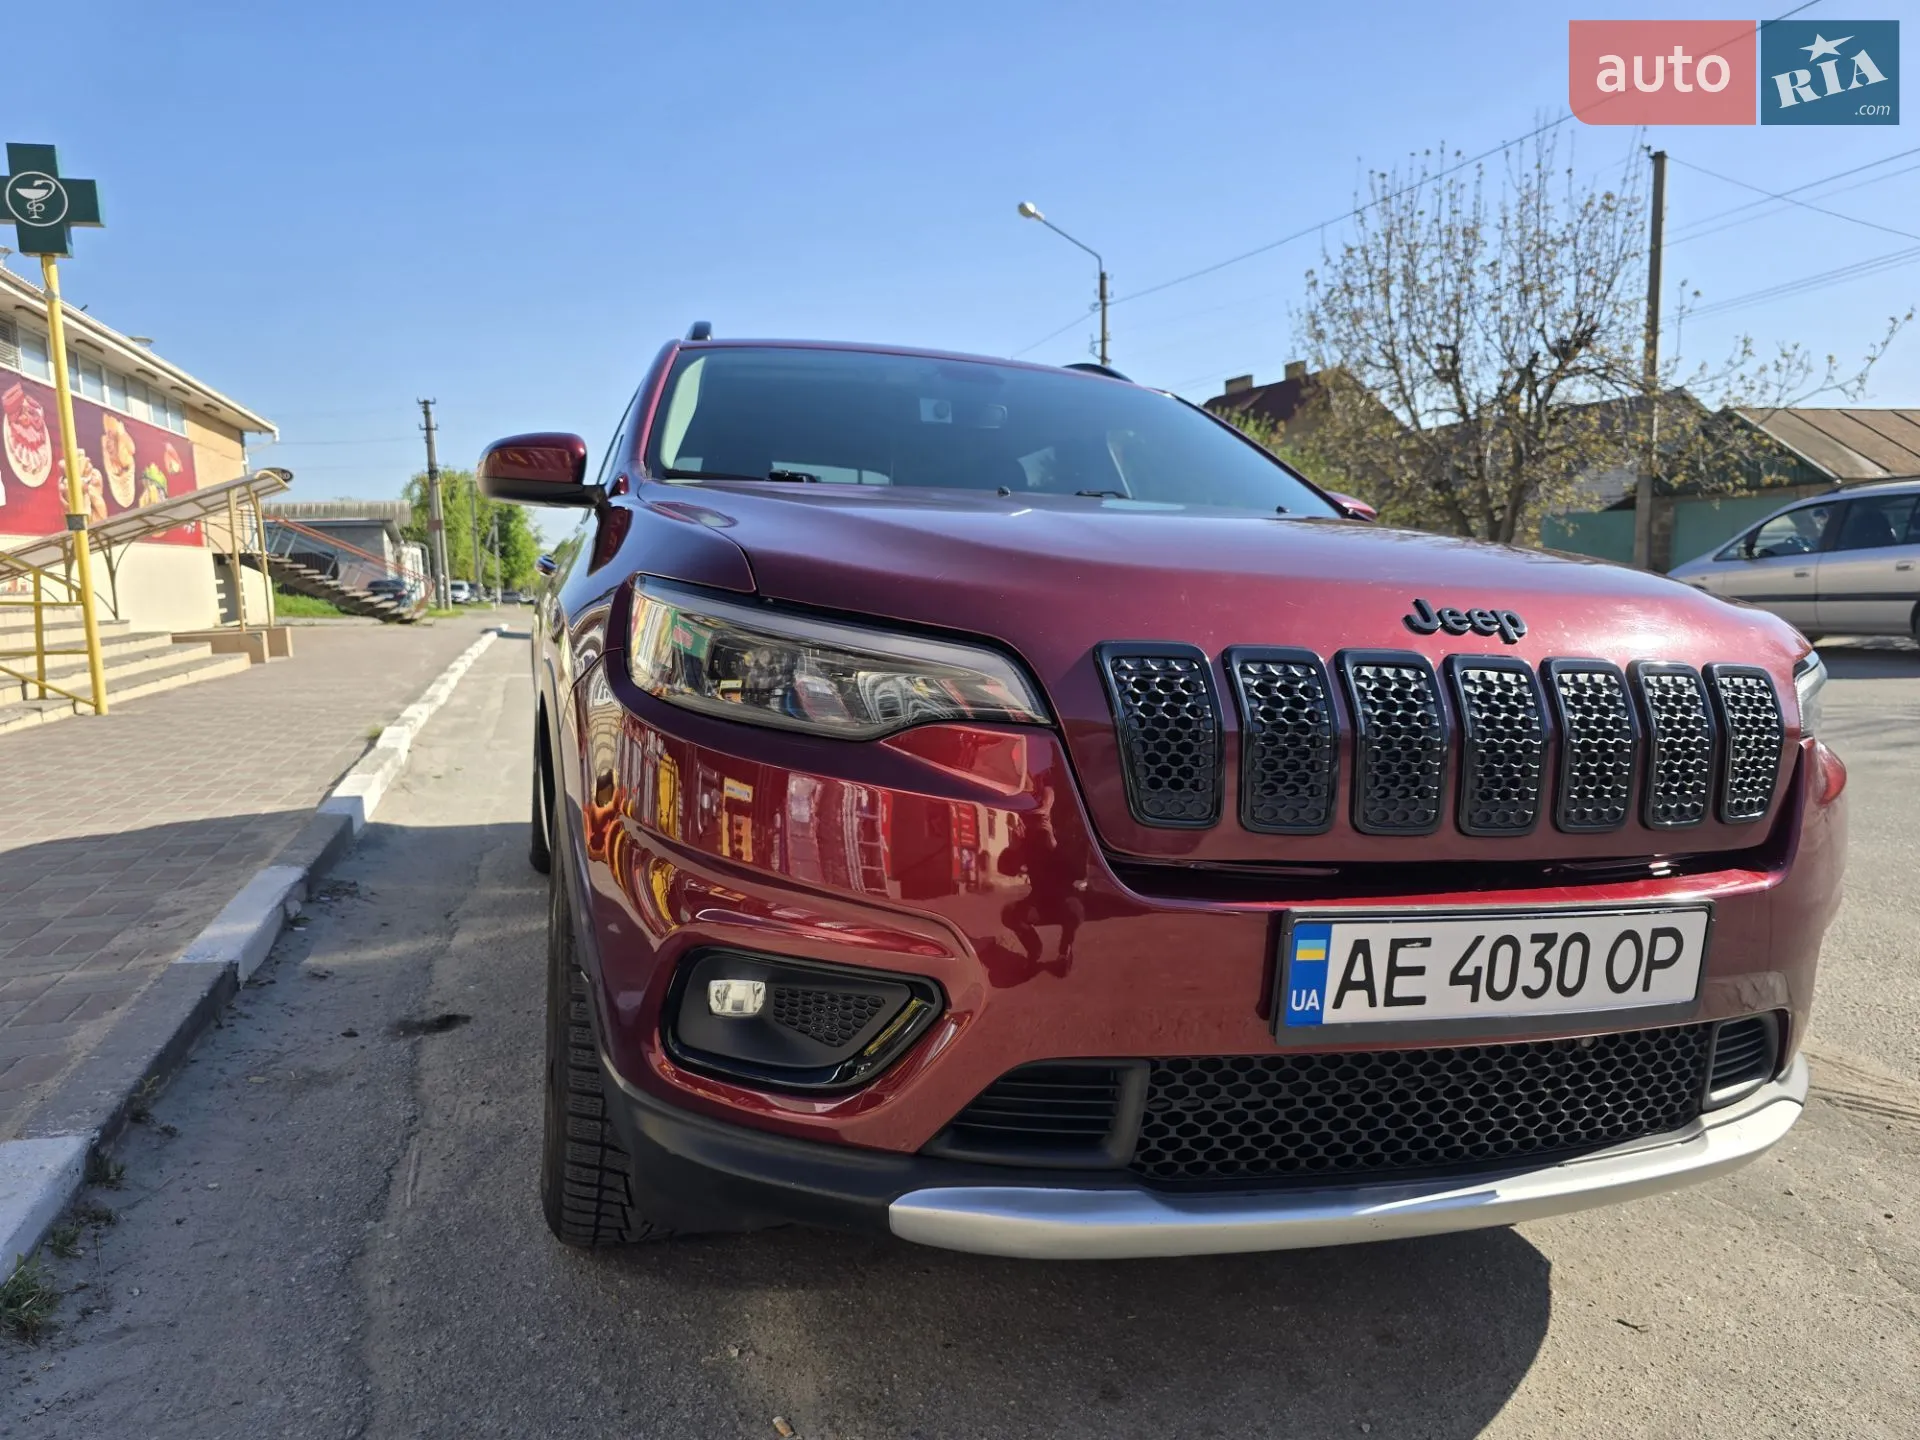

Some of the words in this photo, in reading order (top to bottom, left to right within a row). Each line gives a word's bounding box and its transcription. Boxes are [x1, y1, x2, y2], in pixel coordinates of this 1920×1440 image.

[1402, 598, 1528, 645] Jeep
[1332, 937, 1432, 1009] AE
[1448, 931, 1591, 1003] 4030
[1605, 926, 1685, 994] OP
[1291, 989, 1320, 1012] UA
